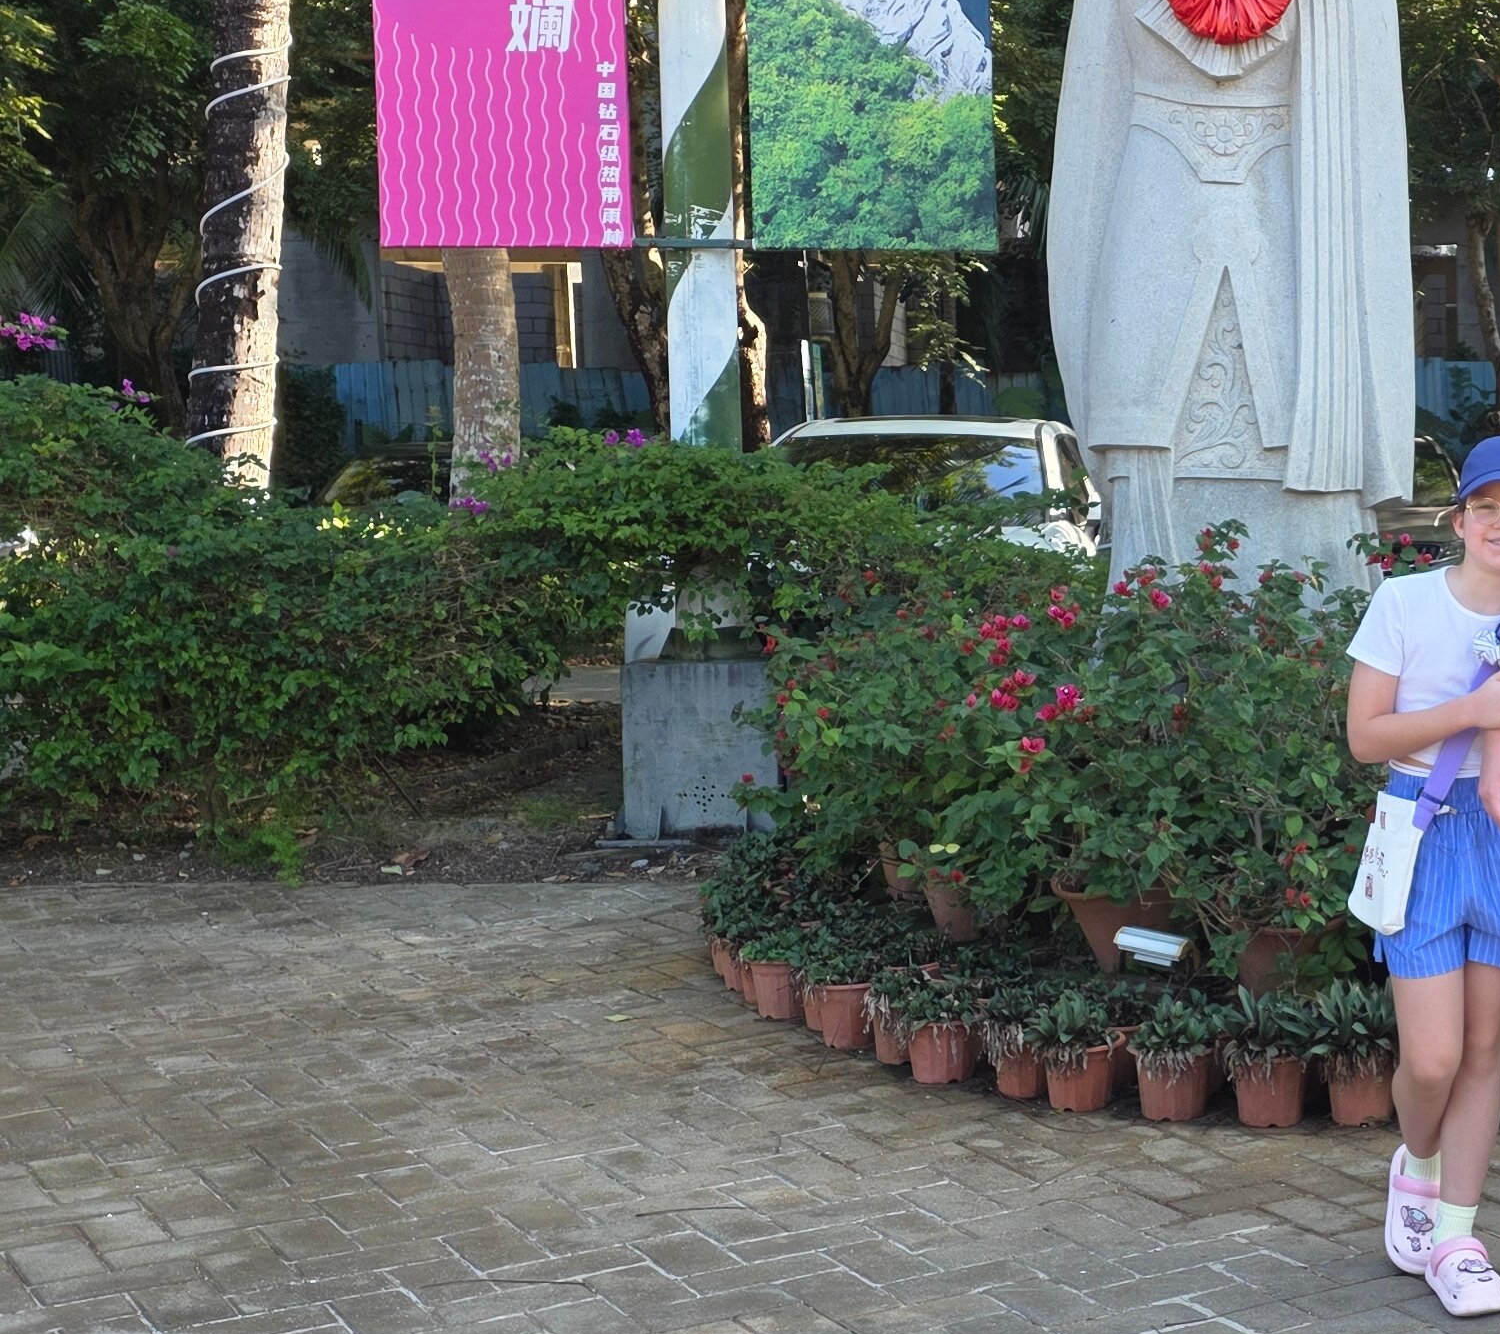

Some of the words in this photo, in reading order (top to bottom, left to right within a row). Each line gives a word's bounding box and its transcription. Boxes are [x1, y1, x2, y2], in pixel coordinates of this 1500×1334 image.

[596, 61, 622, 244] 中国钻石级热带雨林
